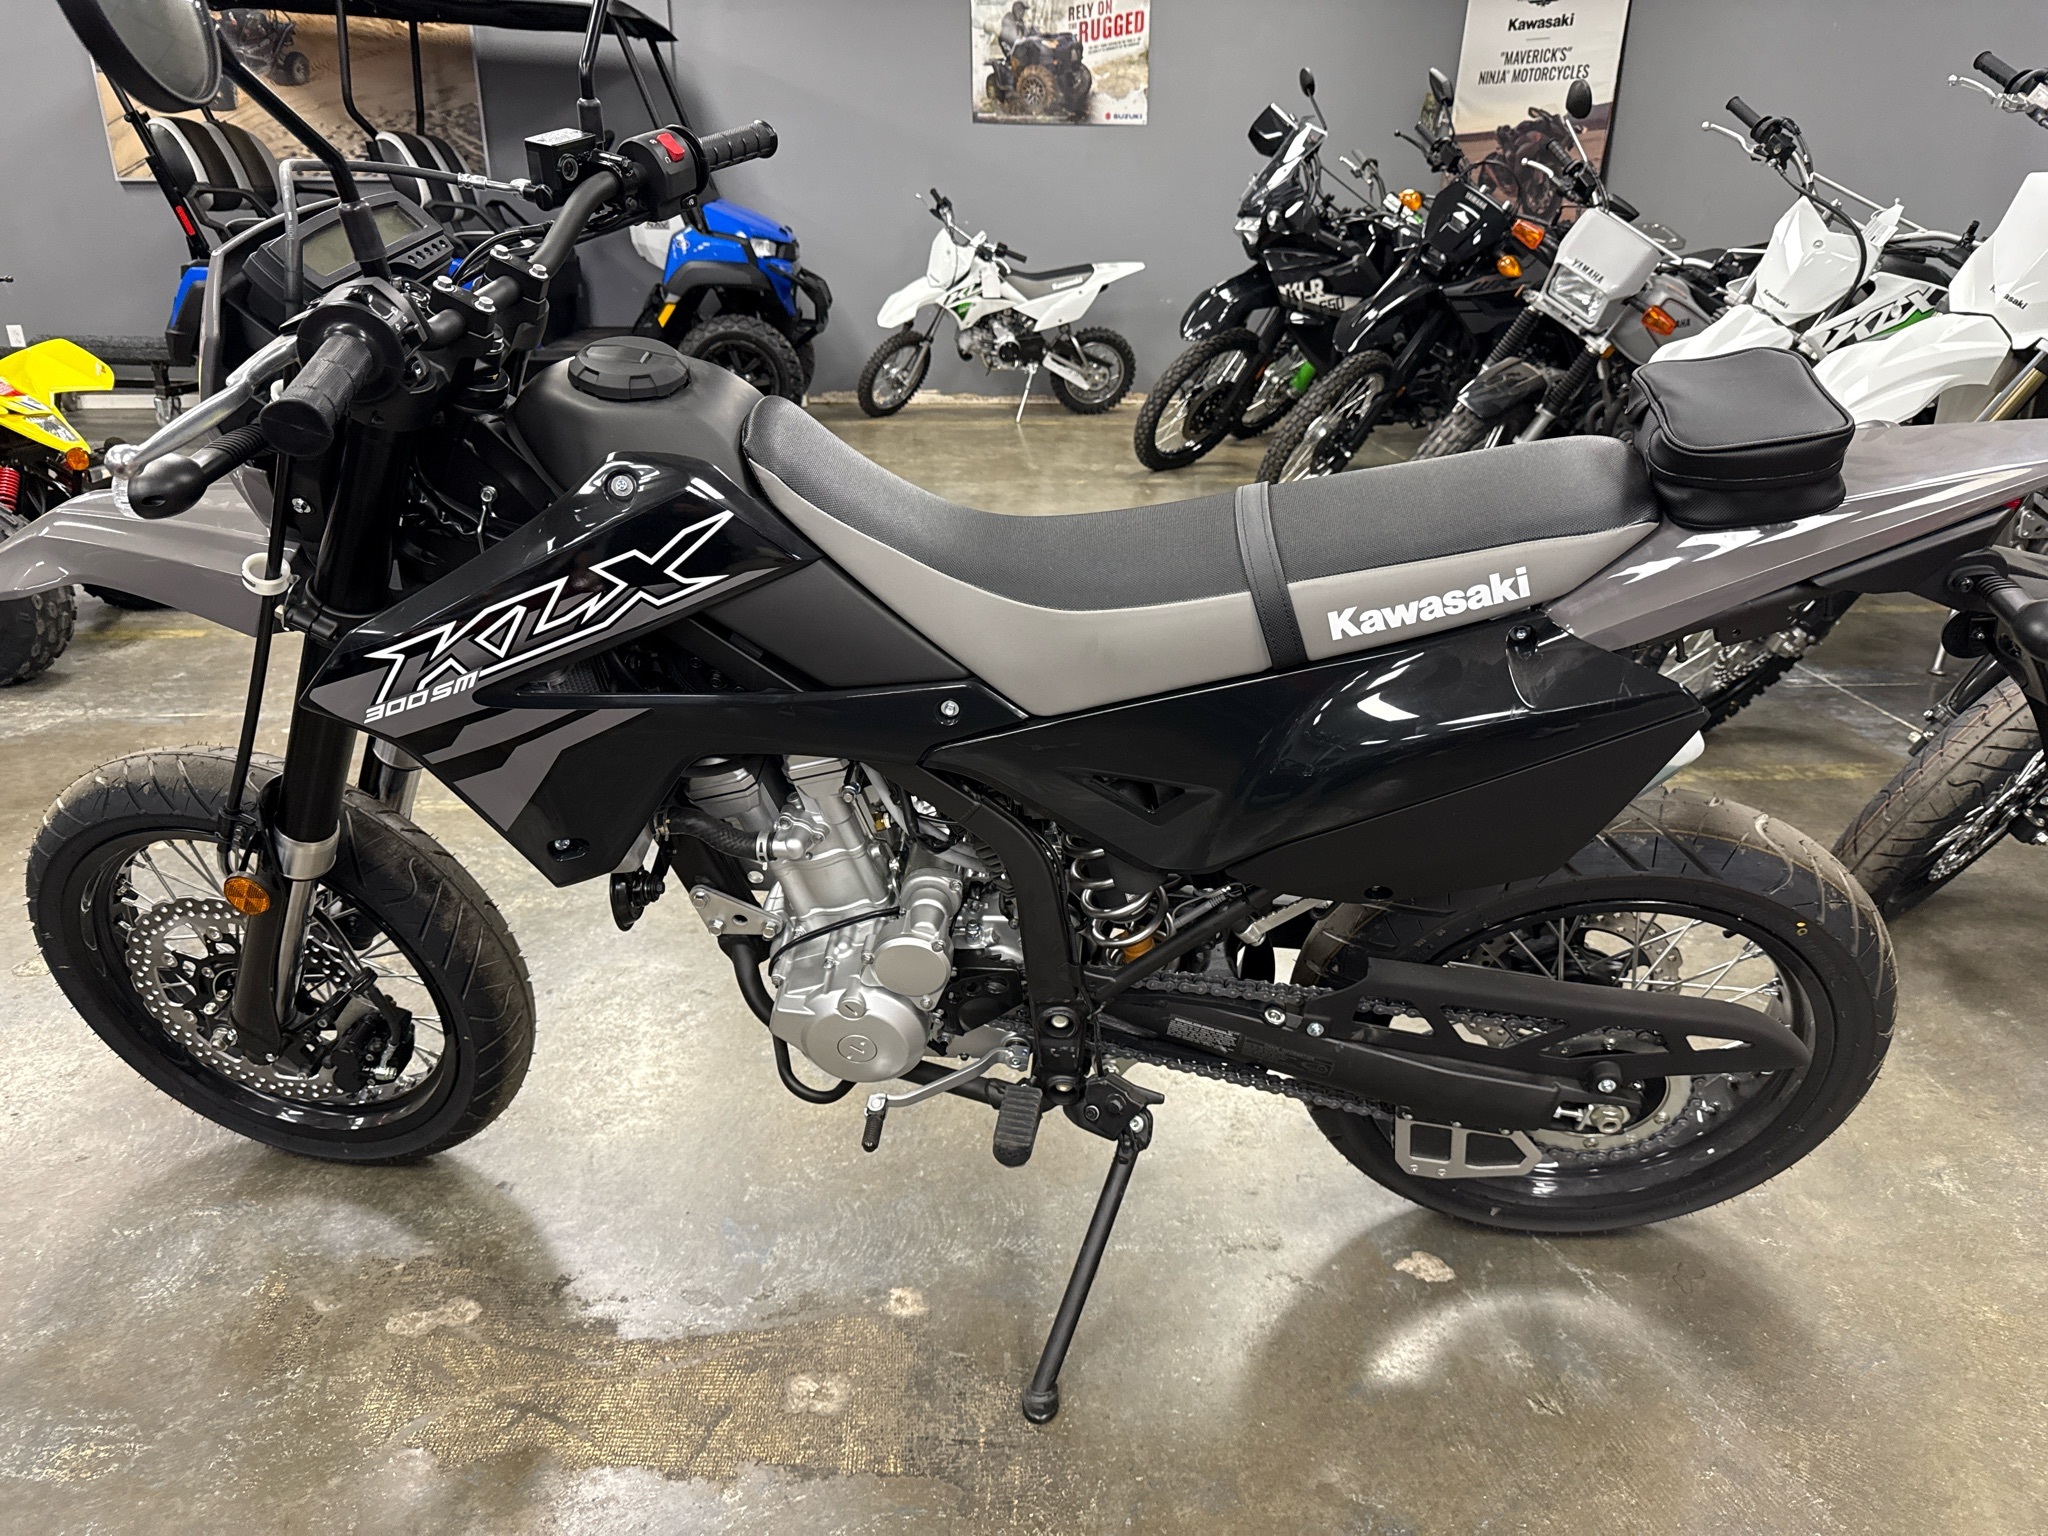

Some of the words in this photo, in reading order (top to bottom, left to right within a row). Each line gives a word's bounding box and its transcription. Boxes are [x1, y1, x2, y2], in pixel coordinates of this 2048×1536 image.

[1068, 2, 1093, 21] RELY
[1098, 0, 1112, 15] ON
[1079, 10, 1145, 43] RUGGED
[1508, 13, 1575, 32] Kawasaki
[1510, 64, 1591, 83] MOTORCYCLES
[1464, 190, 1488, 211] YAMAHA
[1571, 258, 1605, 284] YAMAHA
[1051, 276, 1084, 291] Kawasaki
[1284, 277, 1325, 301] KLR
[1763, 289, 1790, 309] Kawasaki
[363, 510, 735, 706] KLX
[1327, 566, 1531, 641] Kawasaki
